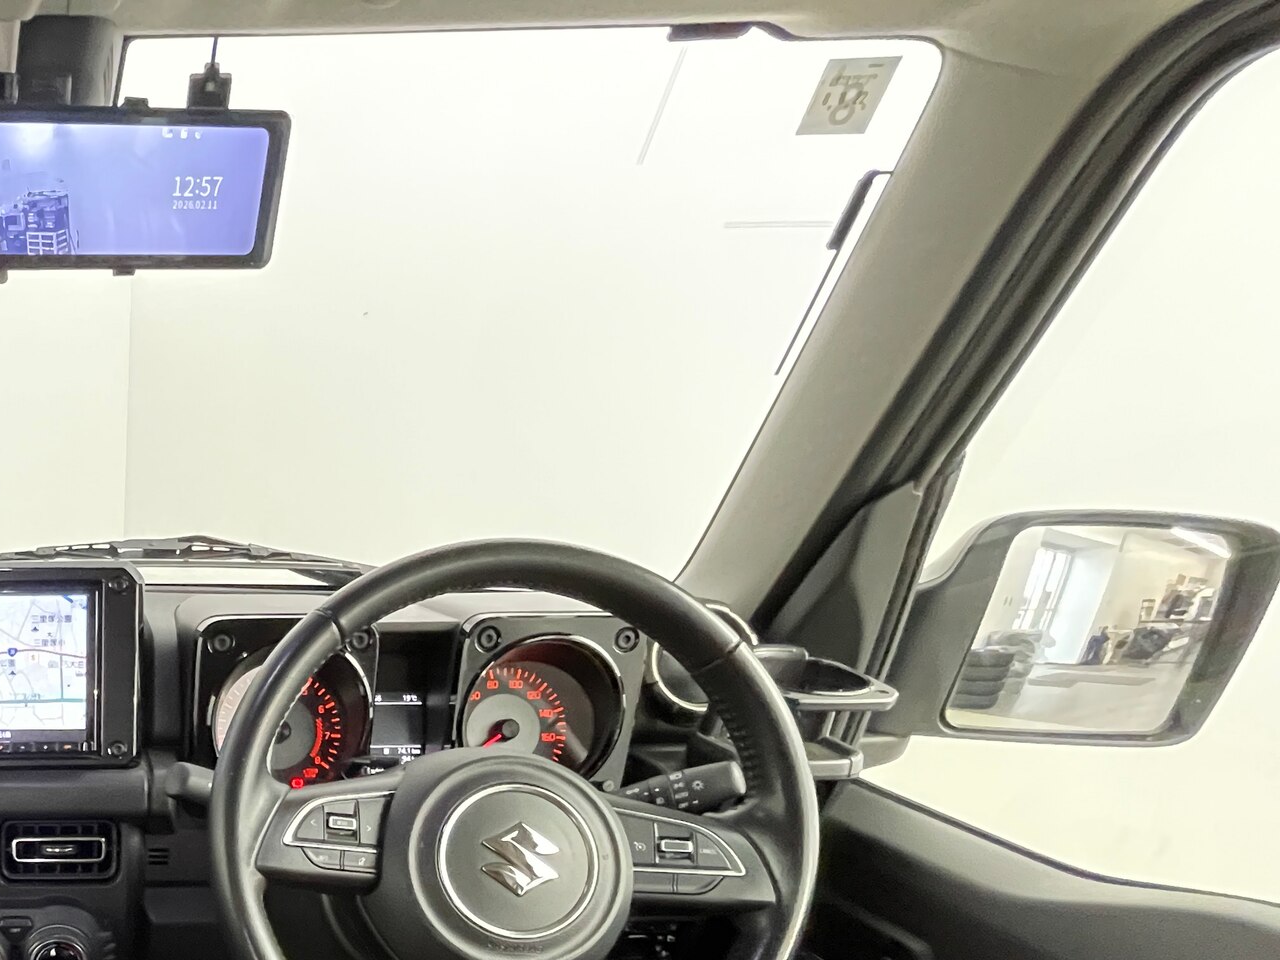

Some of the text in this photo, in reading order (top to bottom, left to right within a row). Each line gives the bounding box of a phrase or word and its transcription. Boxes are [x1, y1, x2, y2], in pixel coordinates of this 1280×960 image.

[172, 176, 223, 197] 12:57
[486, 680, 499, 689] 80
[508, 680, 524, 689] 100
[526, 691, 541, 700] 120
[317, 705, 325, 714] 6
[539, 709, 554, 718] 140
[324, 731, 331, 740] 7
[541, 732, 556, 742] 160
